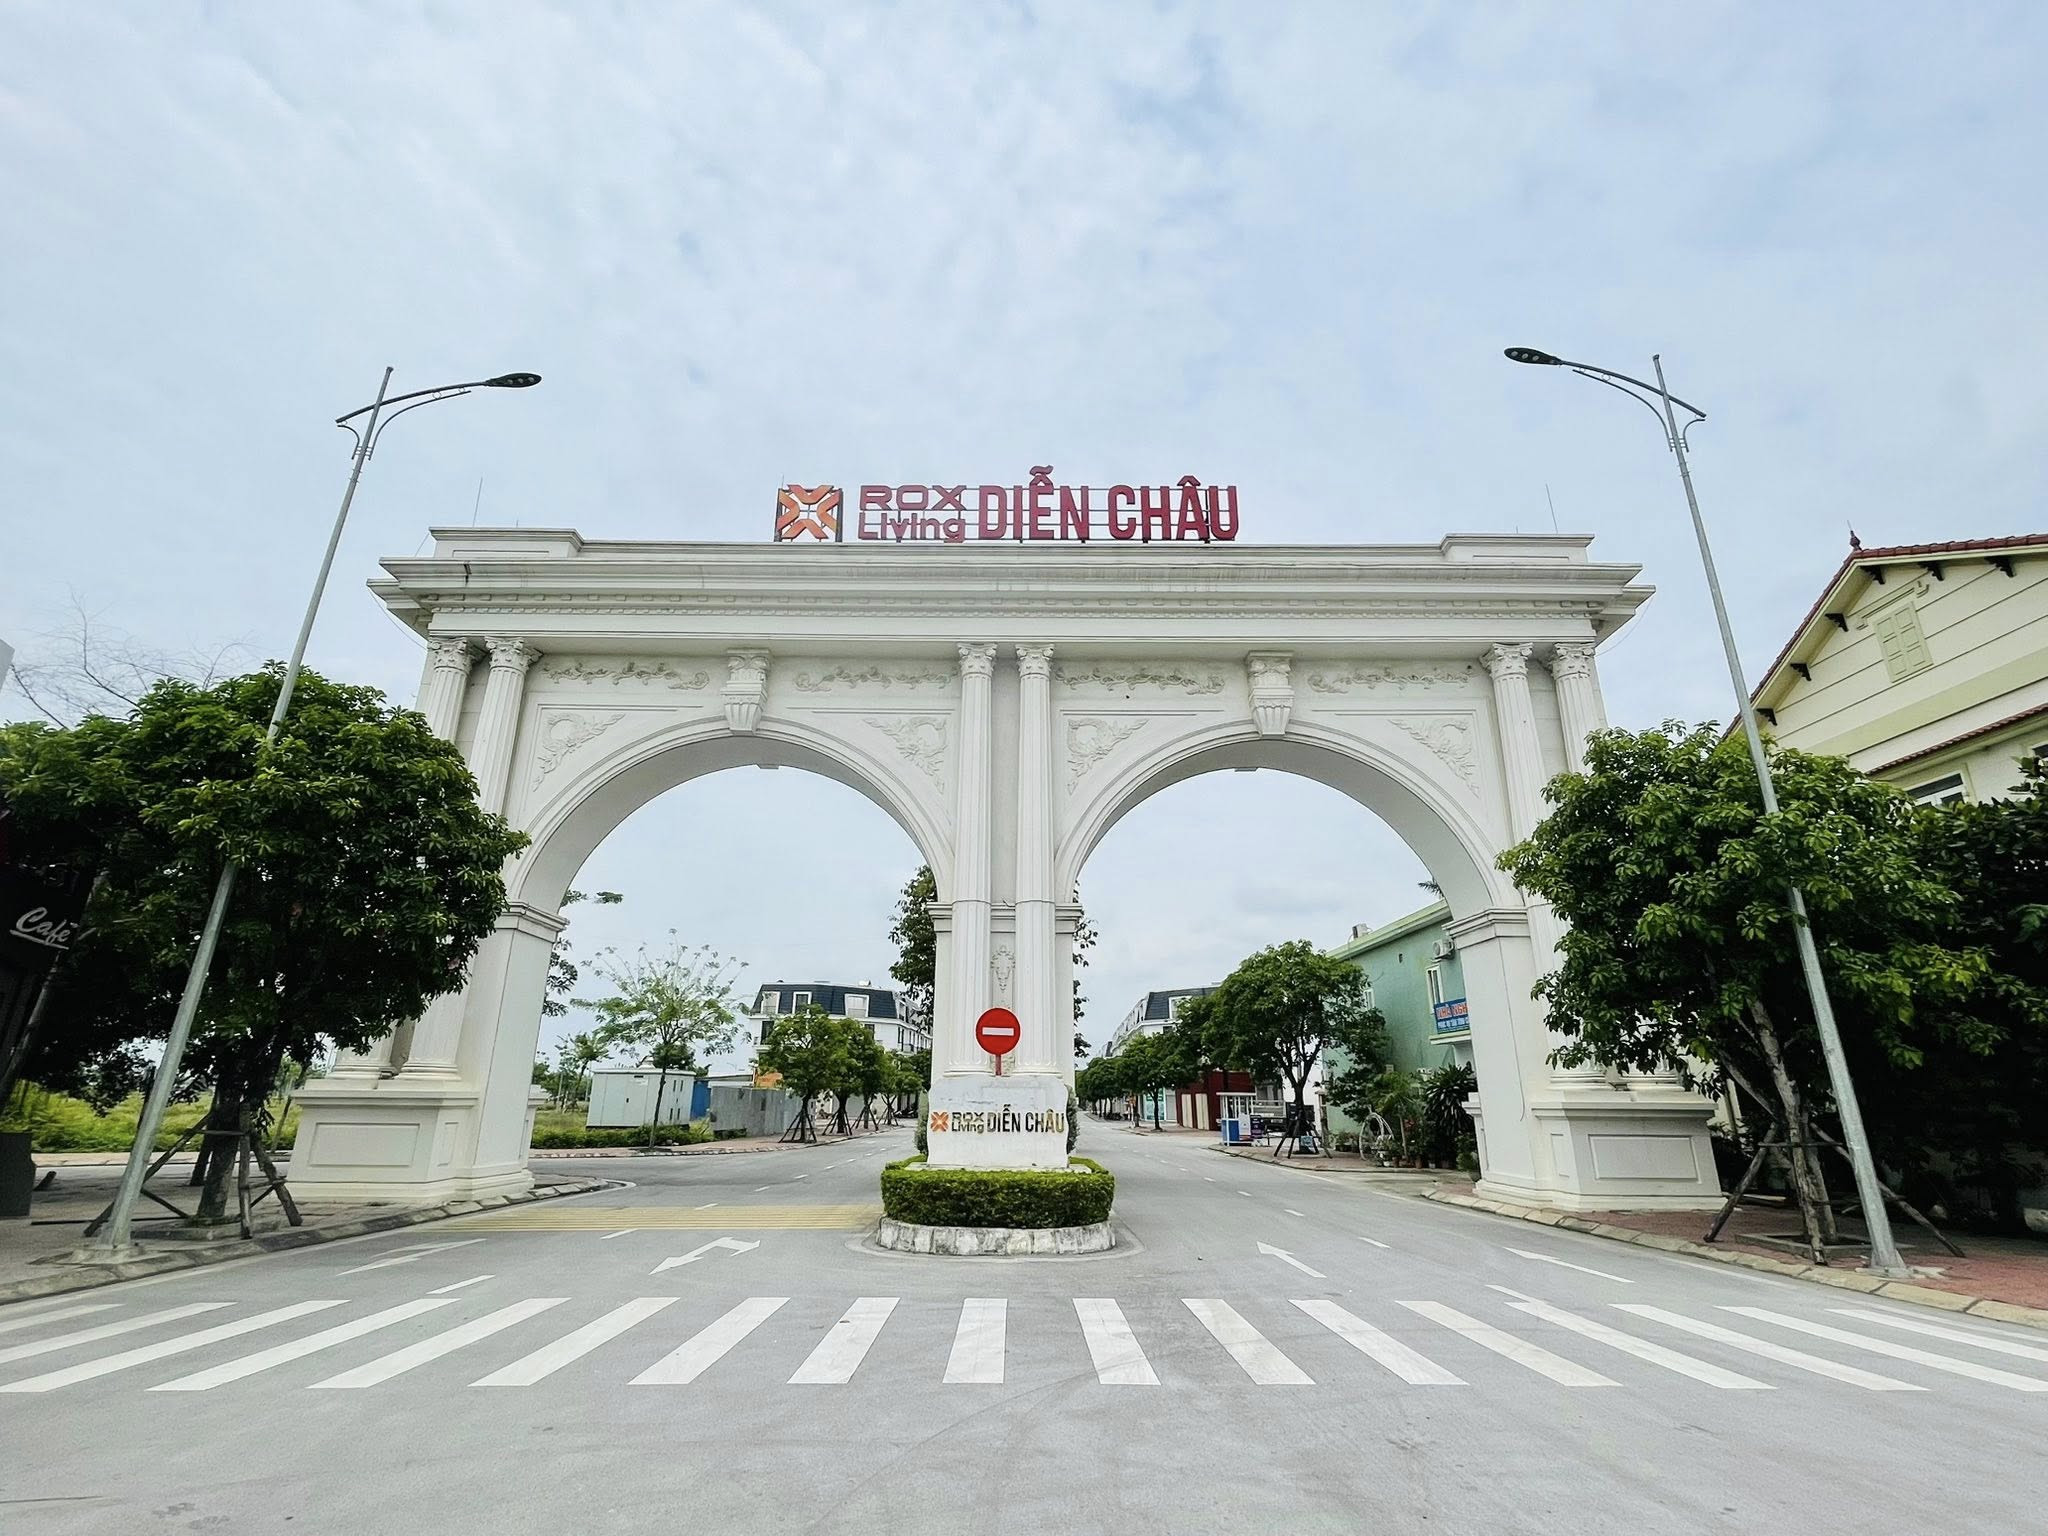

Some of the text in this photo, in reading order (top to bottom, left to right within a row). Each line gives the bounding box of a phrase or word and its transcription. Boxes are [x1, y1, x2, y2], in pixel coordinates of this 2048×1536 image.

[860, 485, 967, 511] ROX
[978, 465, 1239, 541] DIỄN CHÂU
[952, 1112, 984, 1122] ROX
[987, 1104, 1065, 1133] DIỄN CHÂU
